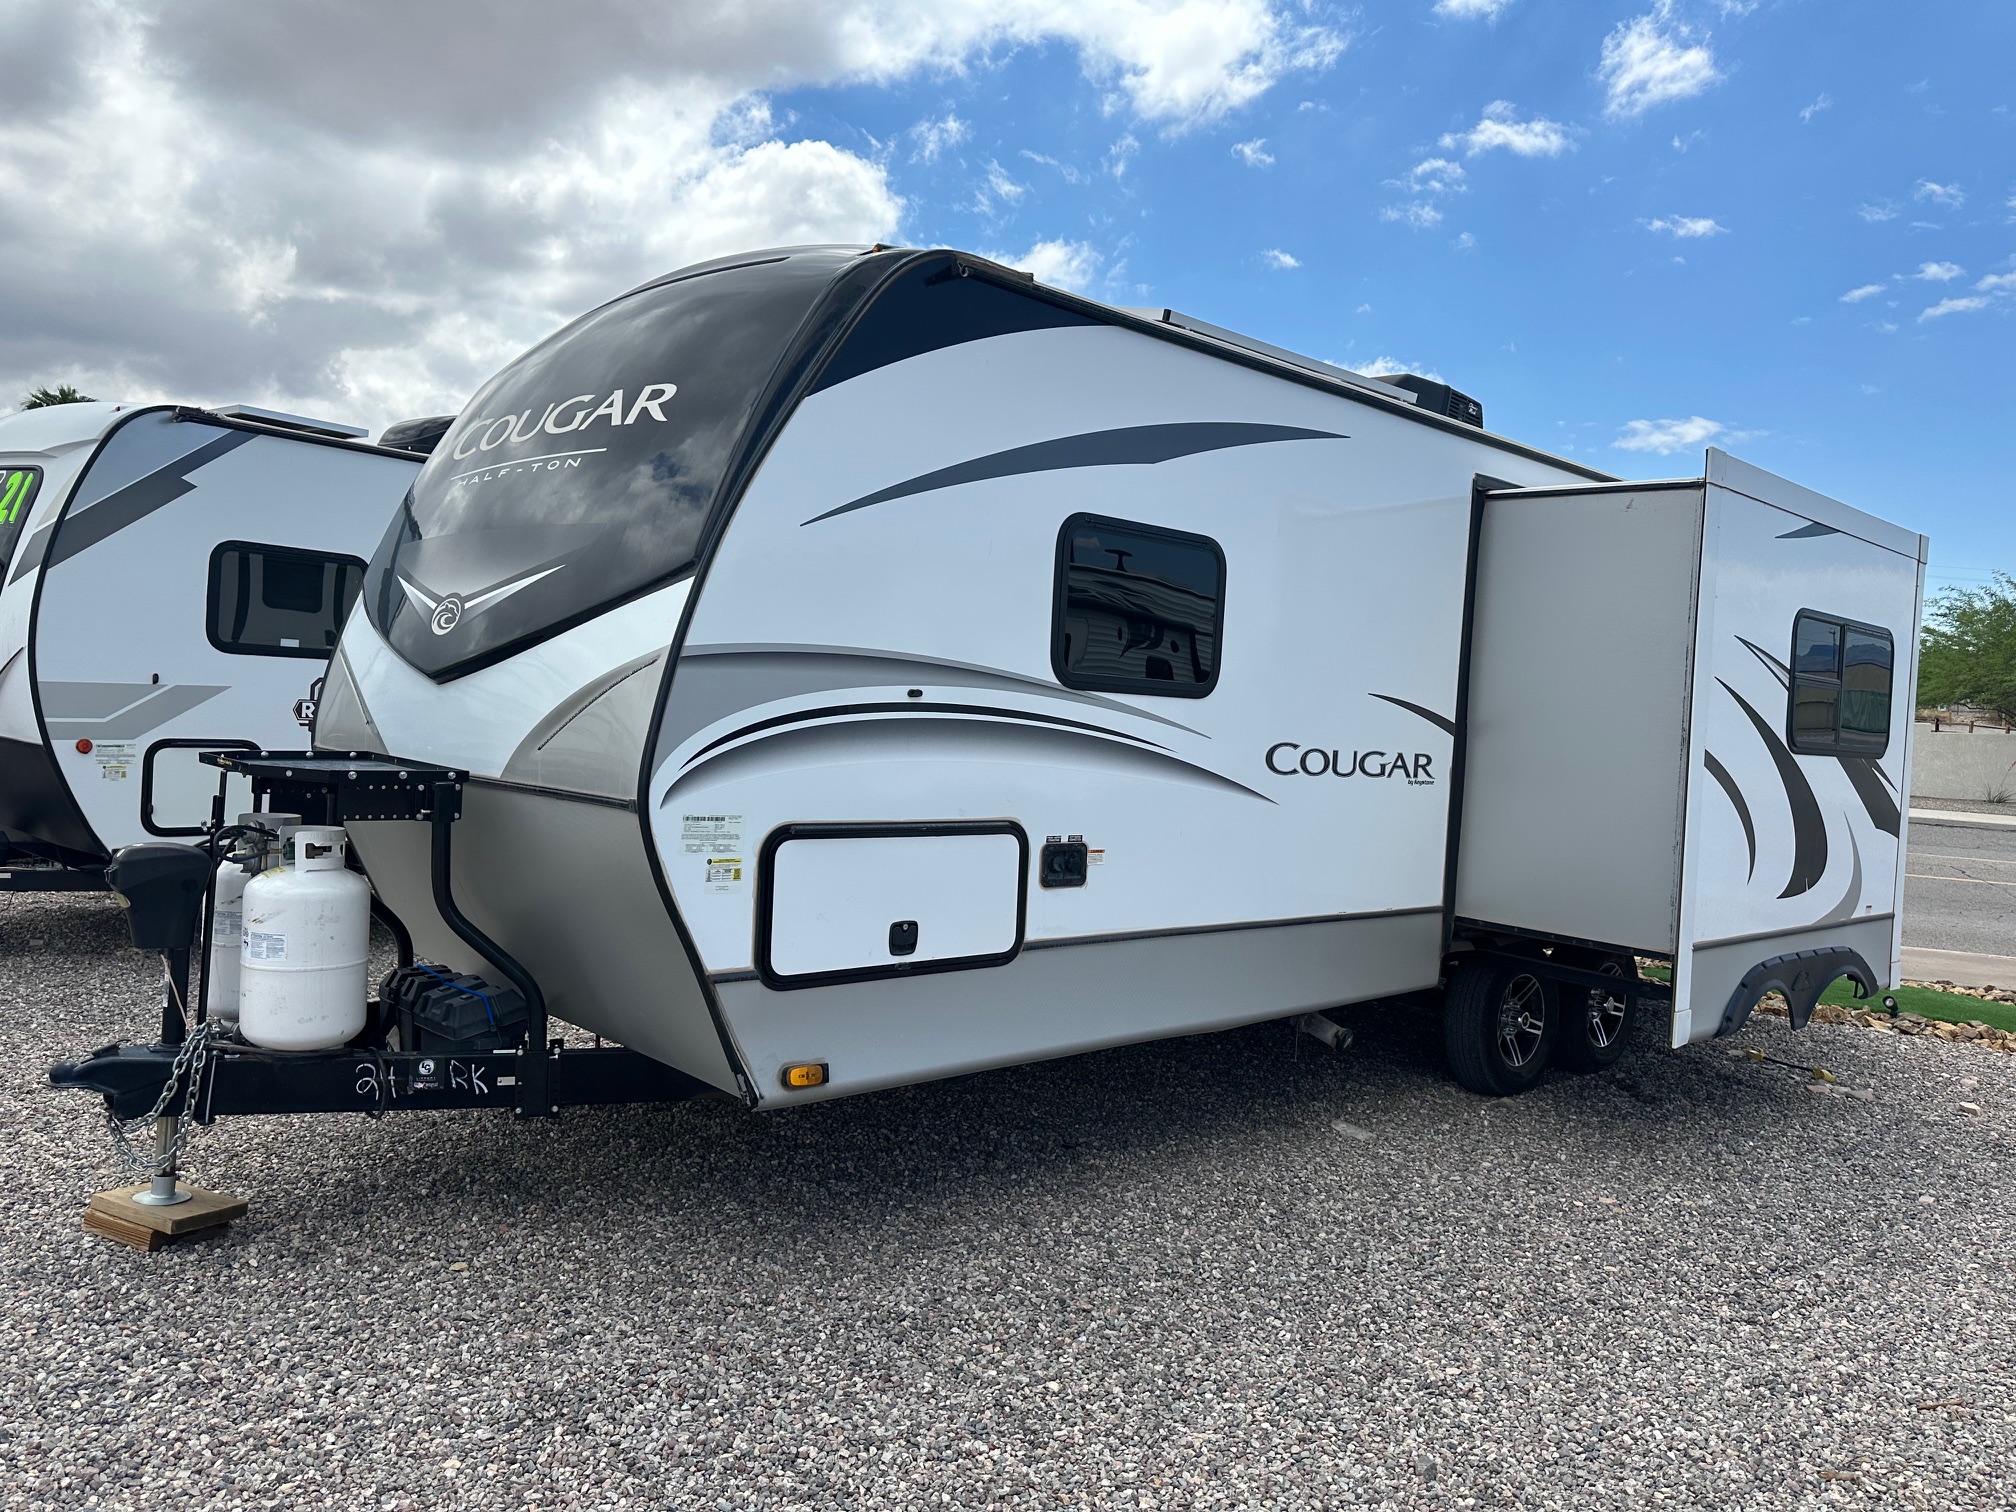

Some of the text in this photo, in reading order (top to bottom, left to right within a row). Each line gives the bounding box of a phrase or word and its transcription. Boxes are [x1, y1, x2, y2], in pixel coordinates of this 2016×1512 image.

[453, 383, 678, 460] COUGAR
[456, 457, 582, 488] HALF-TON
[1265, 742, 1436, 779] COUGAR
[450, 1060, 489, 1095] RK
